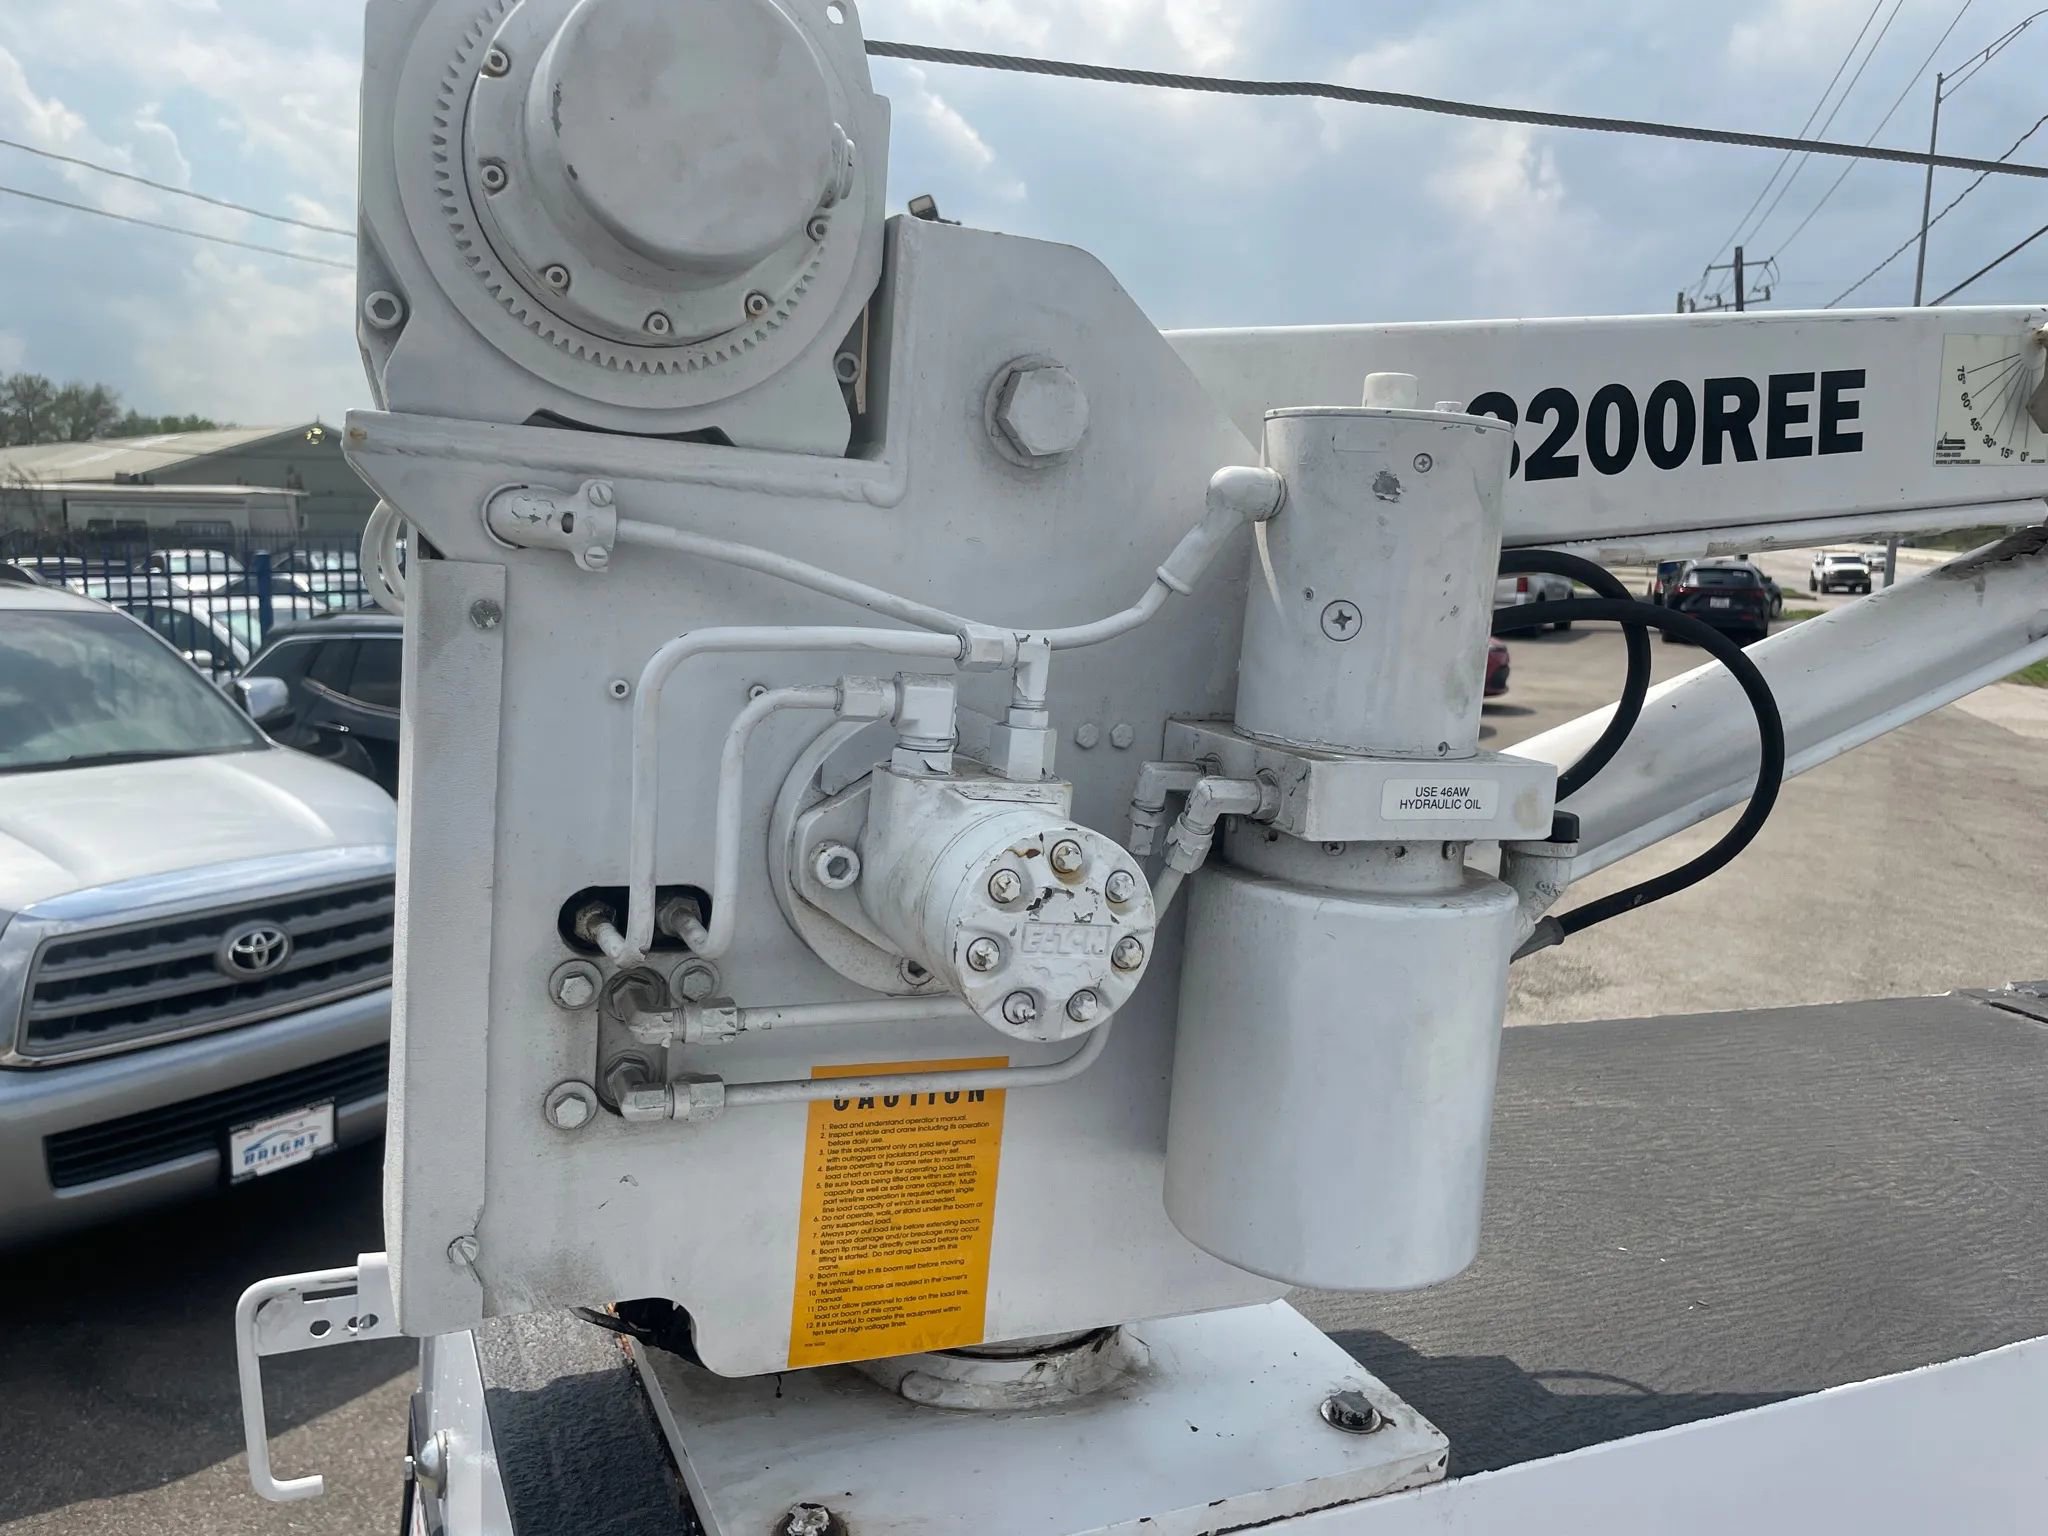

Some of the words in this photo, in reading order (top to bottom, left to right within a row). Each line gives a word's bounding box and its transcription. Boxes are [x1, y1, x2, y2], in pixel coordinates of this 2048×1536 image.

[1415, 787, 1438, 798] USE
[1440, 786, 1470, 797] 46AW
[1399, 799, 1462, 810] HYDRAULIC
[1464, 799, 1482, 809] OIL
[864, 1118, 904, 1127] understand
[904, 1117, 939, 1125] operator's
[828, 1130, 853, 1138] Inspect
[917, 1124, 949, 1132] including
[957, 1121, 990, 1129] operation
[827, 1139, 850, 1147] before
[853, 1144, 891, 1153] equipment
[951, 1138, 976, 1147] ground
[841, 1154, 876, 1162] outriggers
[885, 1150, 919, 1159] jackstand
[919, 1148, 947, 1157] properly
[849, 1162, 883, 1170] operating
[904, 1166, 938, 1174] operating
[822, 1198, 837, 1206] part
[866, 1193, 899, 1201] operation
[906, 1189, 935, 1197] required
[823, 1188, 854, 1197] capacity
[853, 1202, 885, 1210] capacity
[836, 1219, 874, 1228] suspended
[926, 1220, 959, 1228] extending
[853, 1235, 884, 1243] damage
[885, 1232, 909, 1240] and/or
[819, 1247, 840, 1255] Boom
[882, 1265, 903, 1273] boom
[917, 1261, 939, 1269] before
[940, 1258, 965, 1266] moving
[864, 1283, 884, 1291] crane
[894, 1279, 923, 1287] required
[861, 1297, 894, 1308] personnel
[827, 1317, 856, 1326] unlawful
[866, 1314, 893, 1322] operate
[905, 1307, 942, 1317] equipment
[847, 1325, 863, 1333] high
